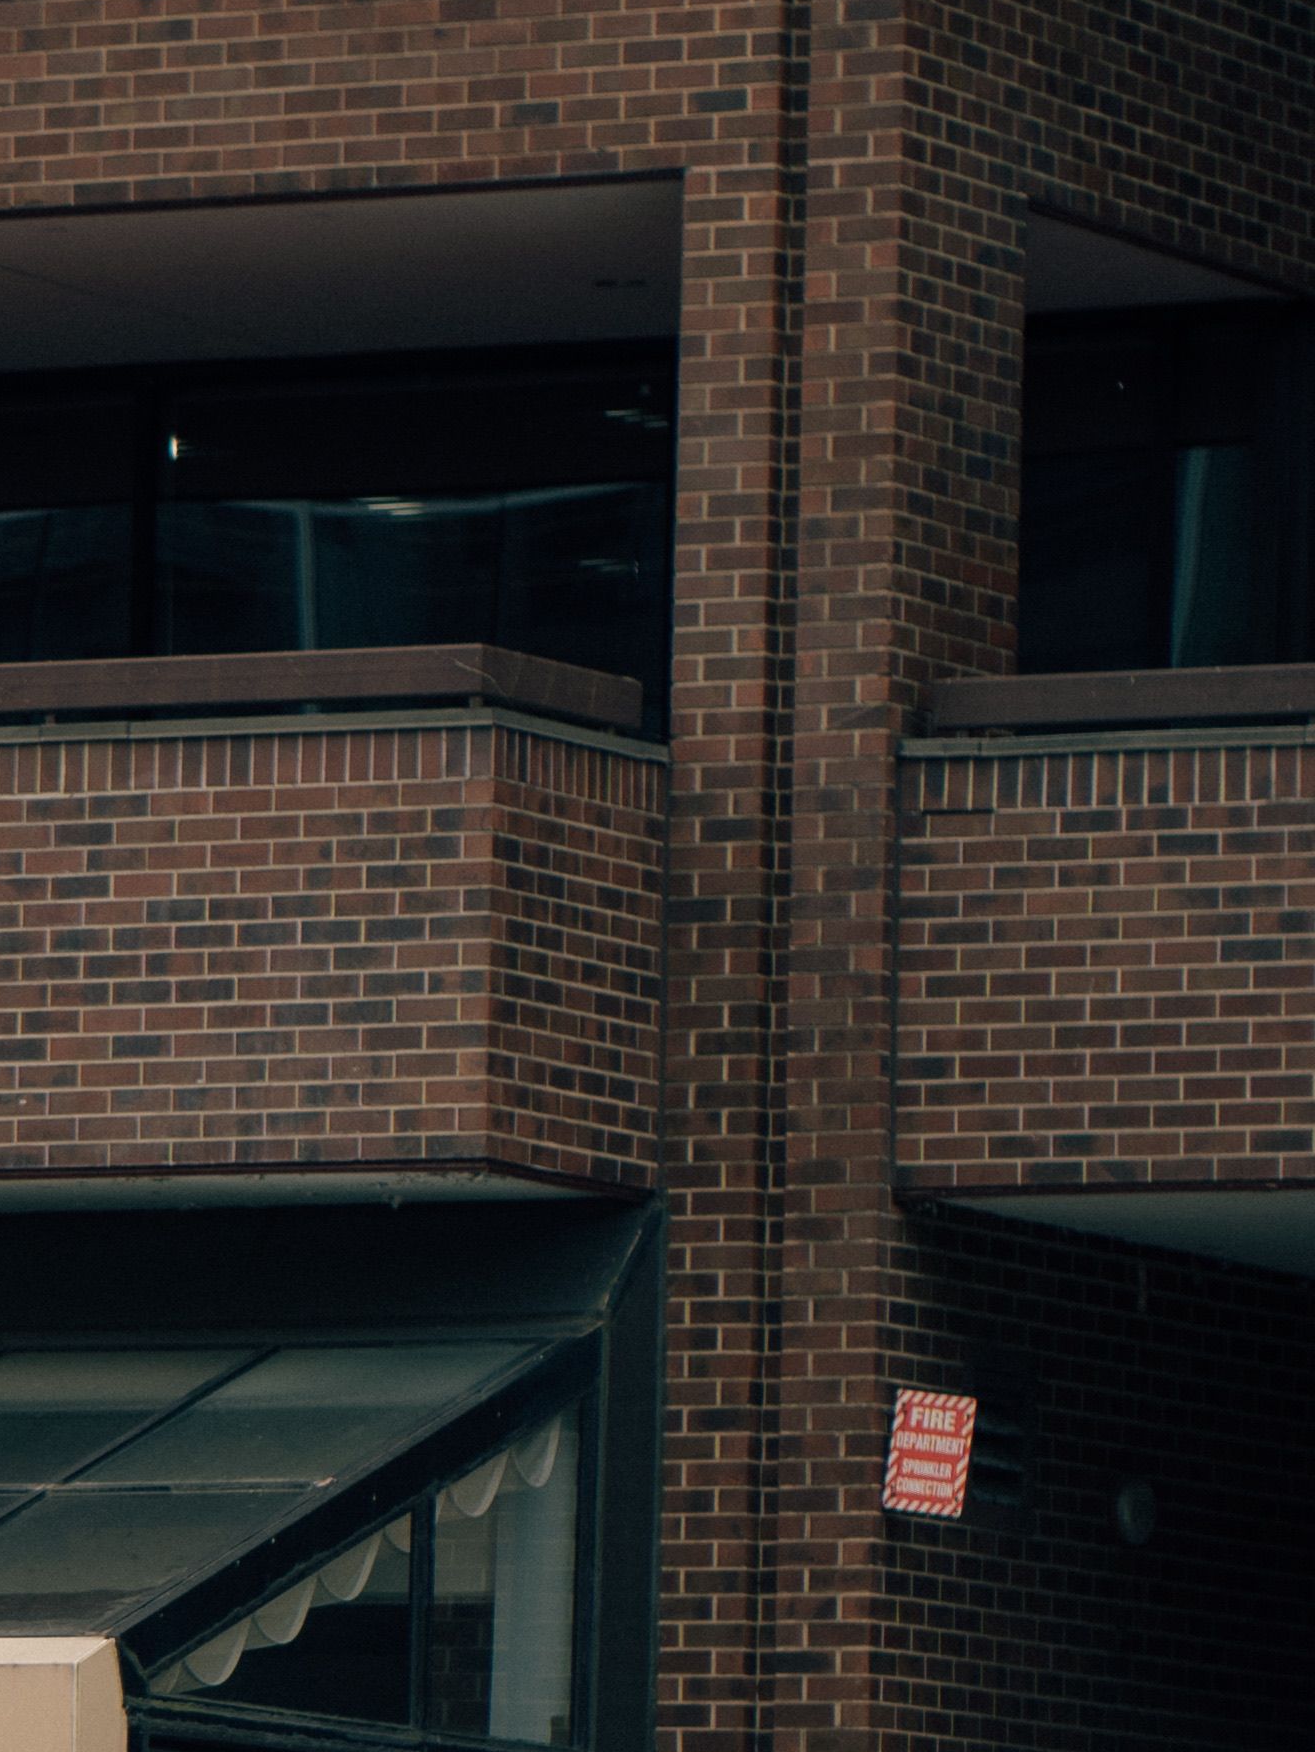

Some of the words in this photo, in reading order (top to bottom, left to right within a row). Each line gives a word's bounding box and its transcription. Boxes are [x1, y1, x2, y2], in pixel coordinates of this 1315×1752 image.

[910, 1406, 956, 1432] FIRE
[896, 1431, 966, 1456] DEPARTMENT
[902, 1458, 952, 1479] SPRINKLER
[896, 1477, 954, 1498] CONNECTION
